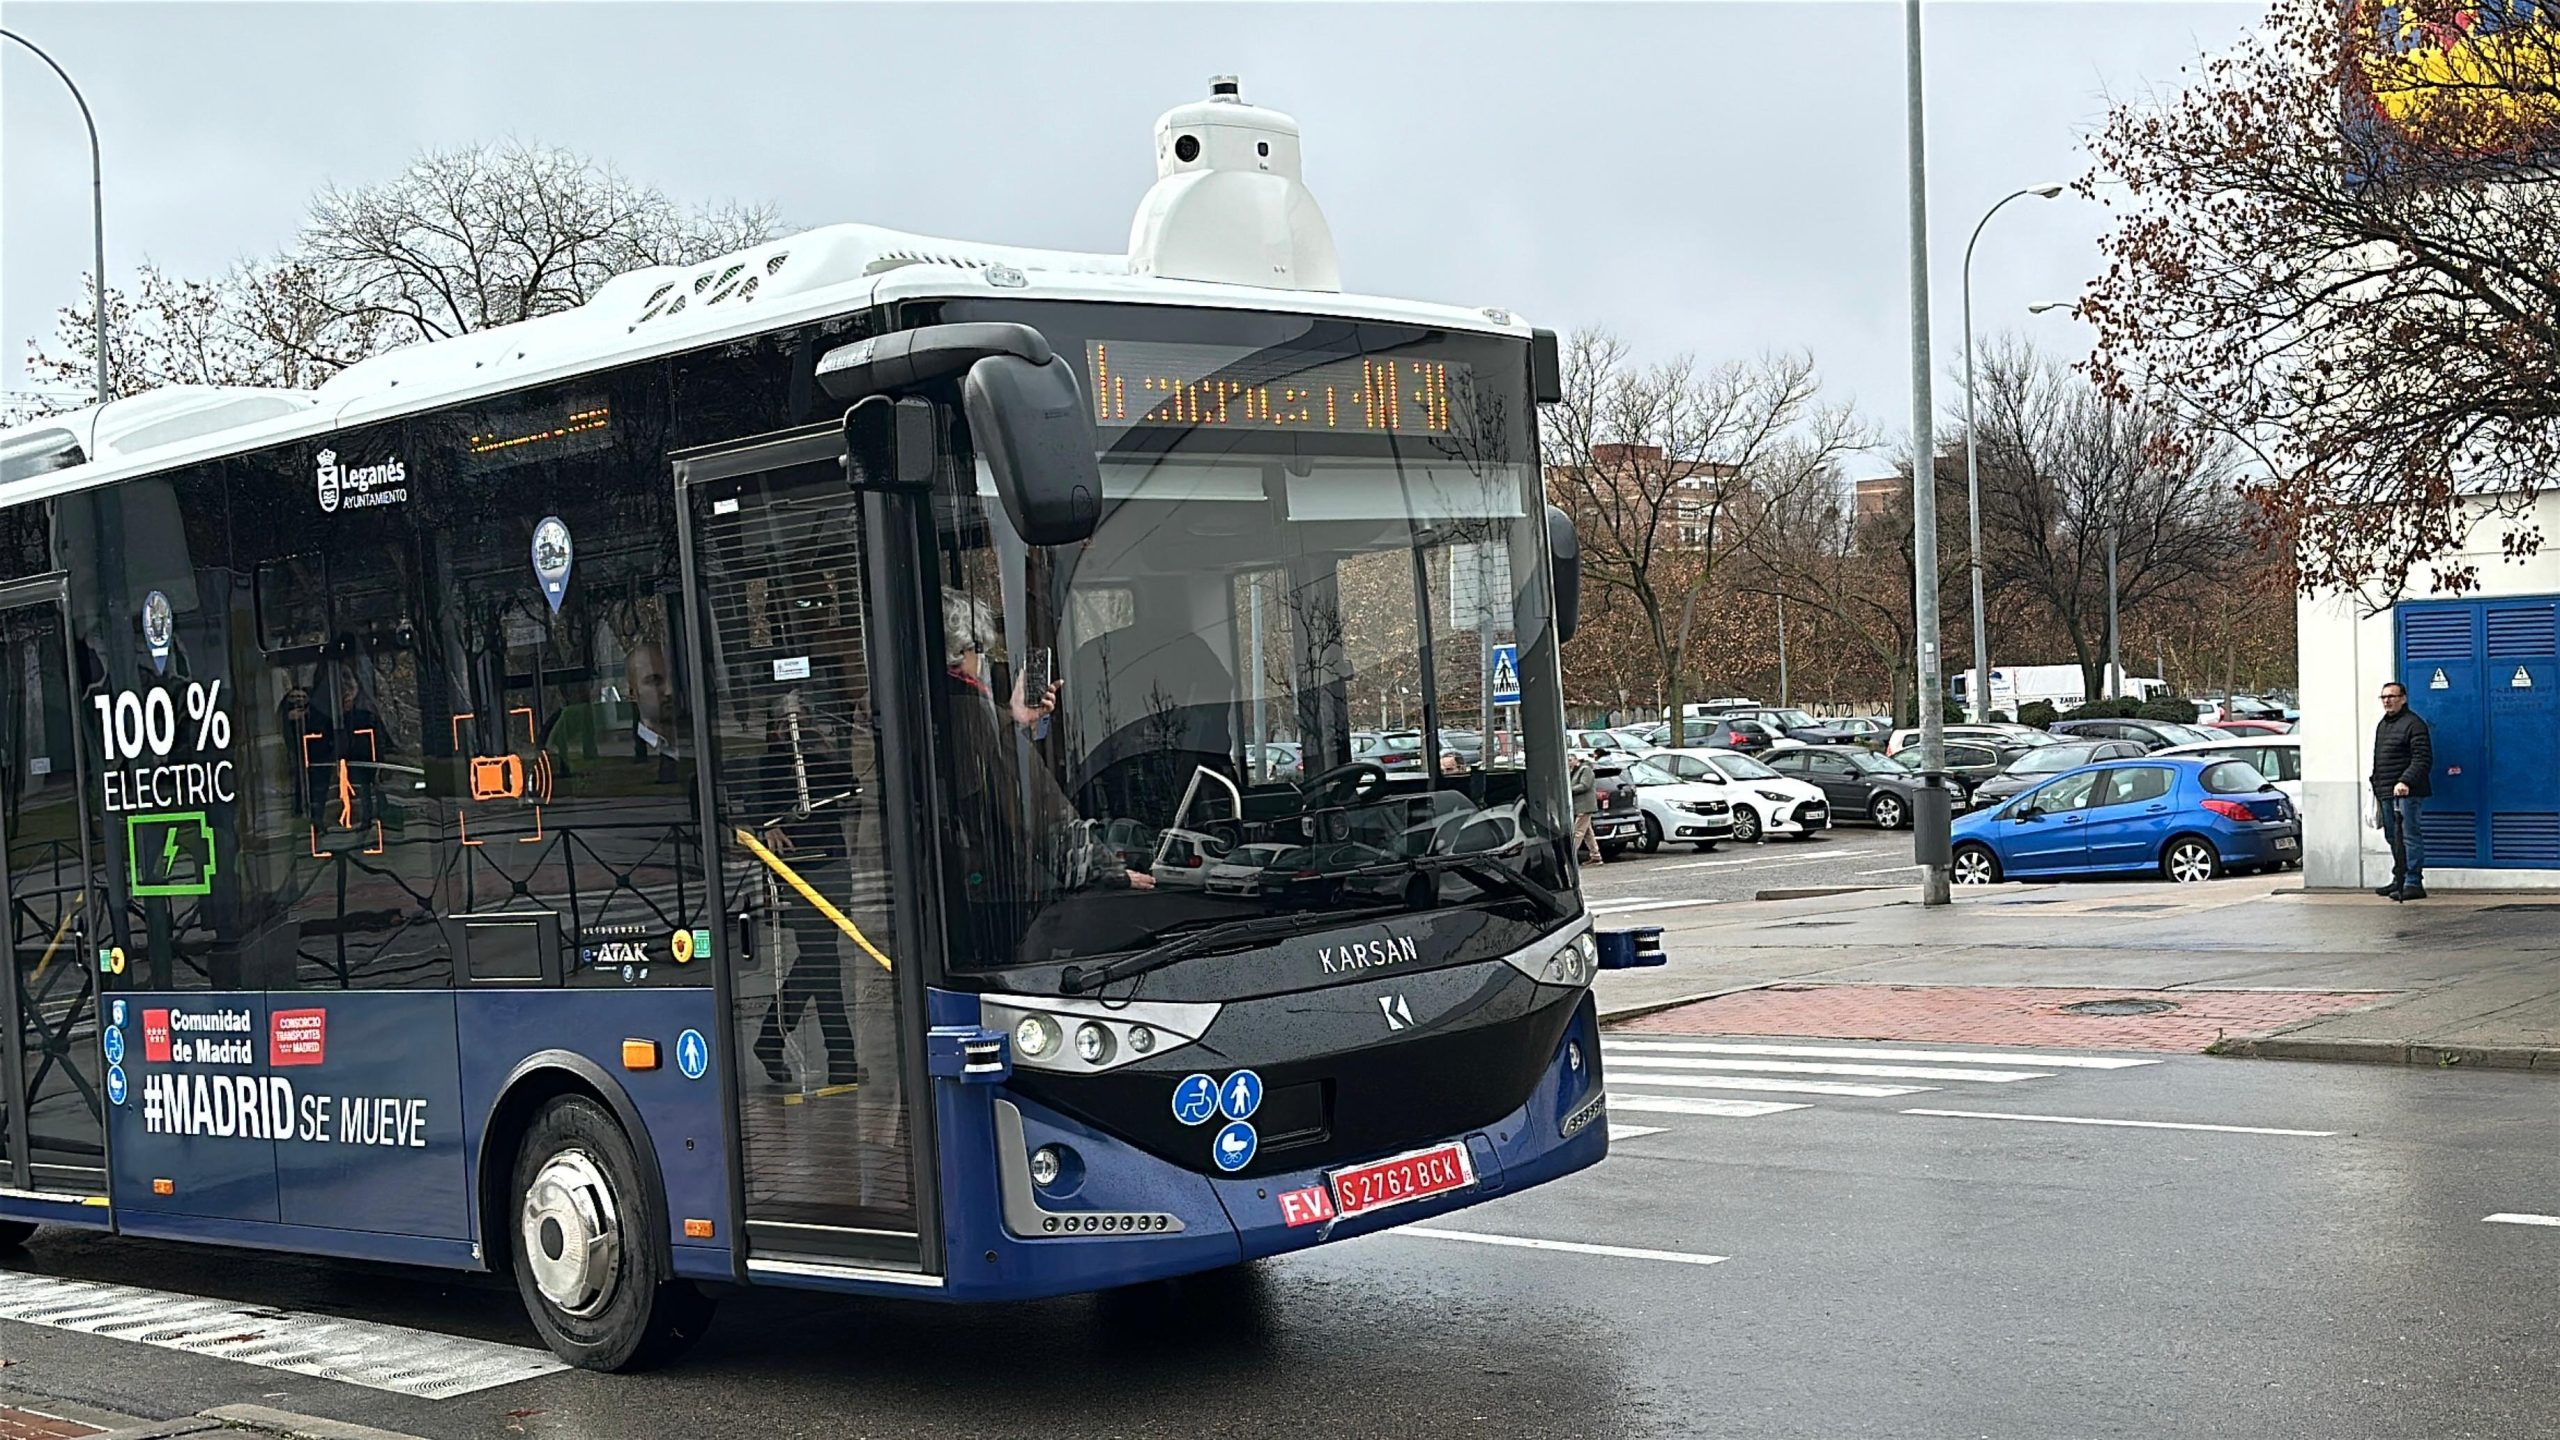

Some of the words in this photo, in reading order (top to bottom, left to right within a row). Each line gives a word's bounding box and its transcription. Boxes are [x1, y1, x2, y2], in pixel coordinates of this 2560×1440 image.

[341, 456, 405, 492] Leganés
[343, 489, 407, 509] AYUNTAMIENTO
[95, 686, 175, 760] 100
[187, 679, 231, 752] %
[104, 760, 235, 811] ELECTRIC
[583, 943, 650, 962] e-ATAK
[1319, 936, 1418, 974] KARSAN
[170, 1008, 250, 1032] Comunidad
[173, 1039, 192, 1062] de
[196, 1039, 252, 1064] Madrid
[144, 1073, 294, 1140] #MADRID
[300, 1095, 331, 1141] SE
[340, 1097, 427, 1147] MUEVE
[1342, 1181, 1355, 1206] S
[1360, 1166, 1414, 1203] 2762
[1417, 1156, 1456, 1187] BCK
[1283, 1190, 1330, 1222] F.V.
